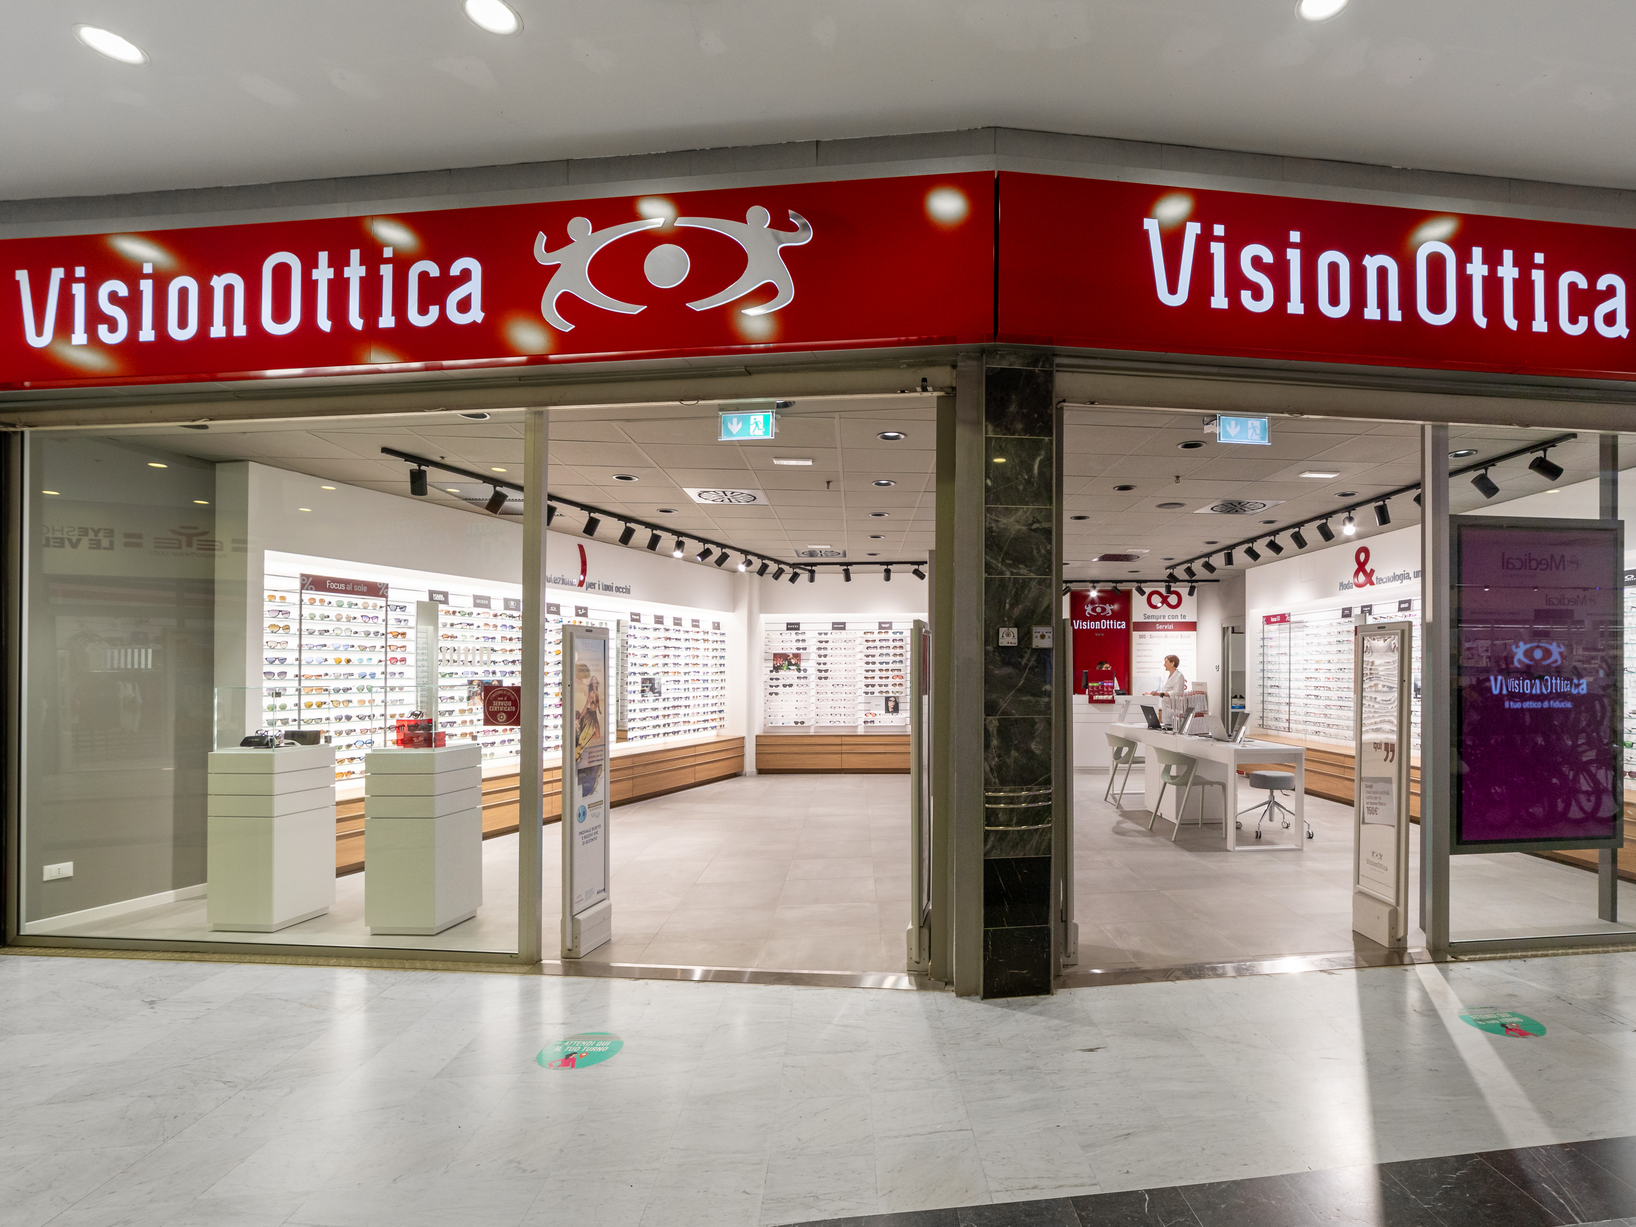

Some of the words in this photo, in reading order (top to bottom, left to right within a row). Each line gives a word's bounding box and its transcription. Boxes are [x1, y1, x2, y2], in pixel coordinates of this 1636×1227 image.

[1143, 217, 1630, 340] VisionOttica
[15, 247, 485, 348] VisionOttica
[1339, 580, 1354, 591] Moda
[1353, 546, 1375, 588] &
[326, 580, 345, 590] Focus
[353, 584, 367, 592] sole
[1143, 613, 1166, 622] Sempre
[1073, 620, 1126, 629] VisionOttica
[1542, 700, 1549, 708] di
